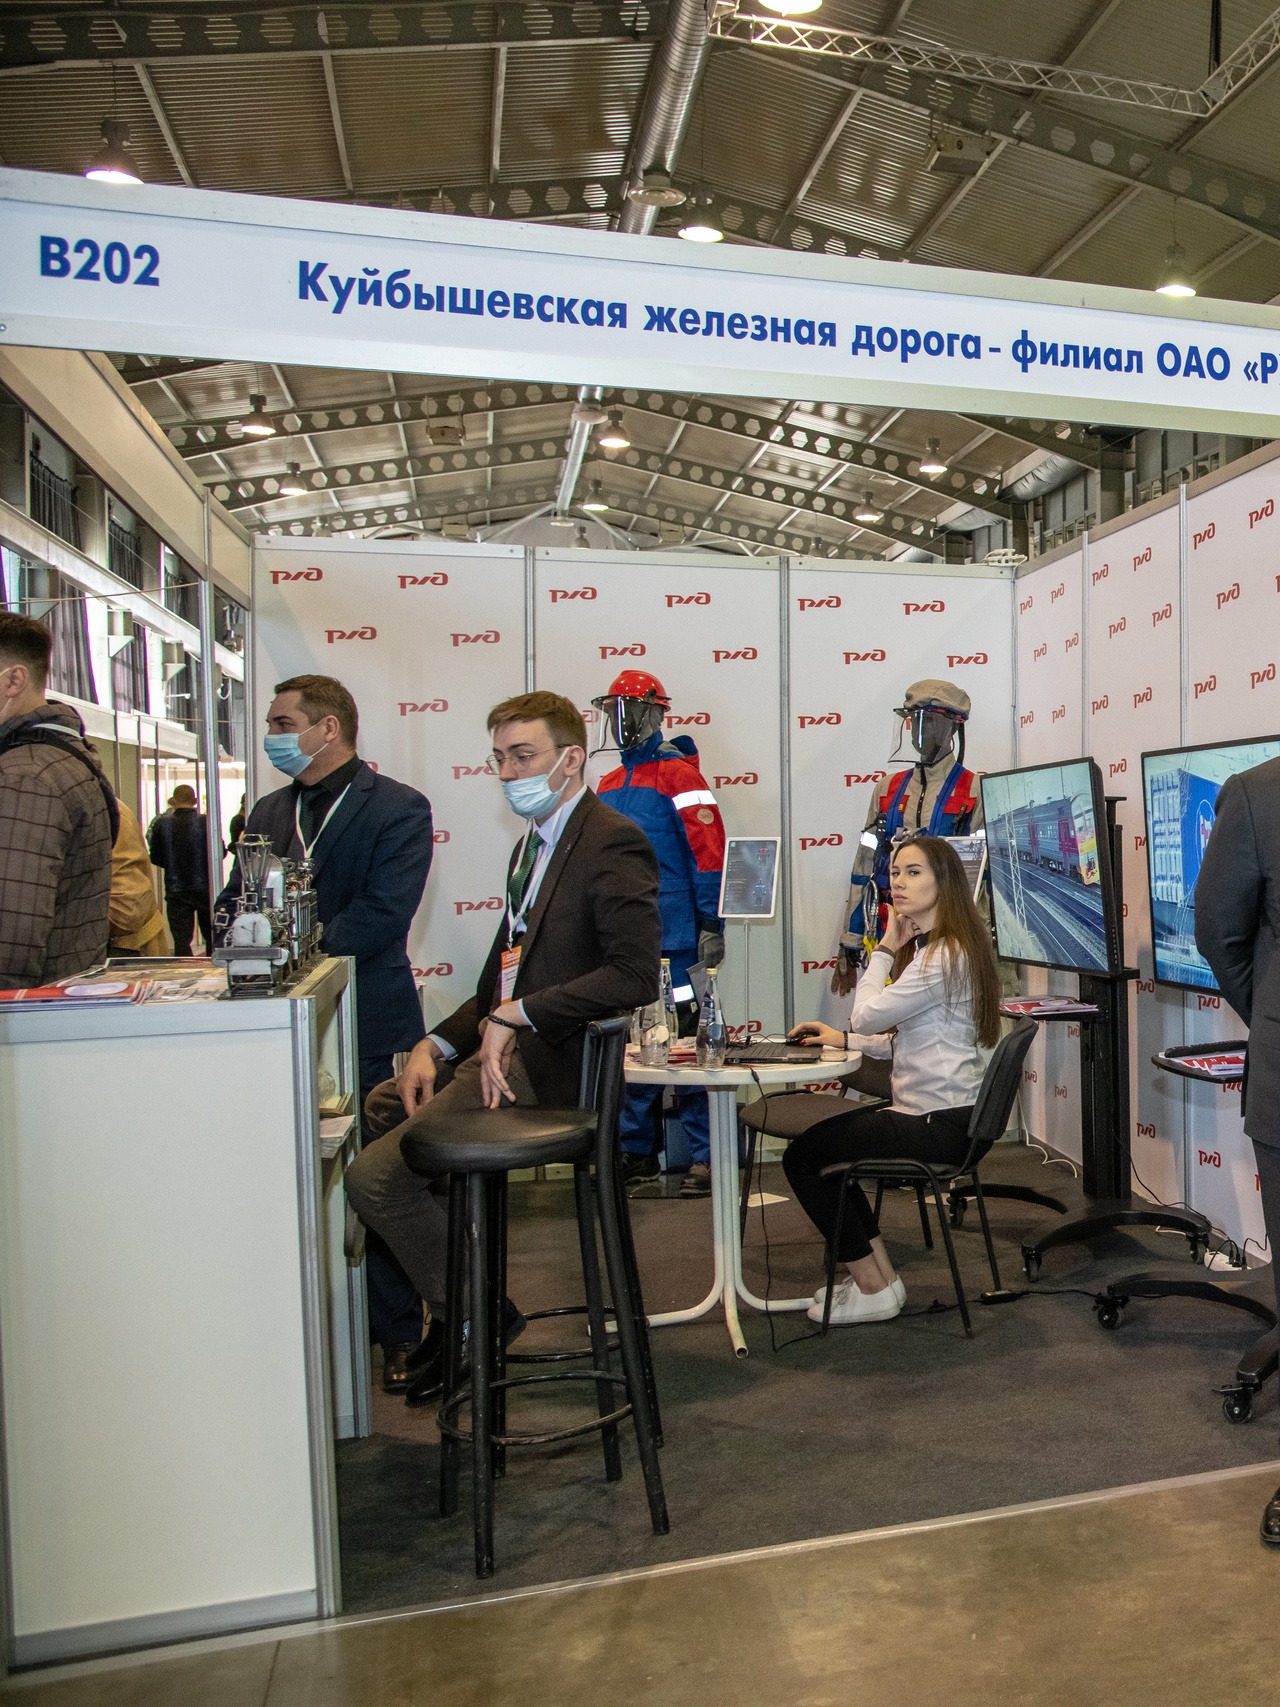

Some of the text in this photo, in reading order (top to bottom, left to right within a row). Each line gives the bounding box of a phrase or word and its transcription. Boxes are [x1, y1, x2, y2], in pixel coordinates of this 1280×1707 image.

[298, 260, 627, 329] Куйбышевская
[643, 304, 836, 347] железная
[1011, 329, 1143, 374] филиал
[1156, 342, 1231, 381] ОАО
